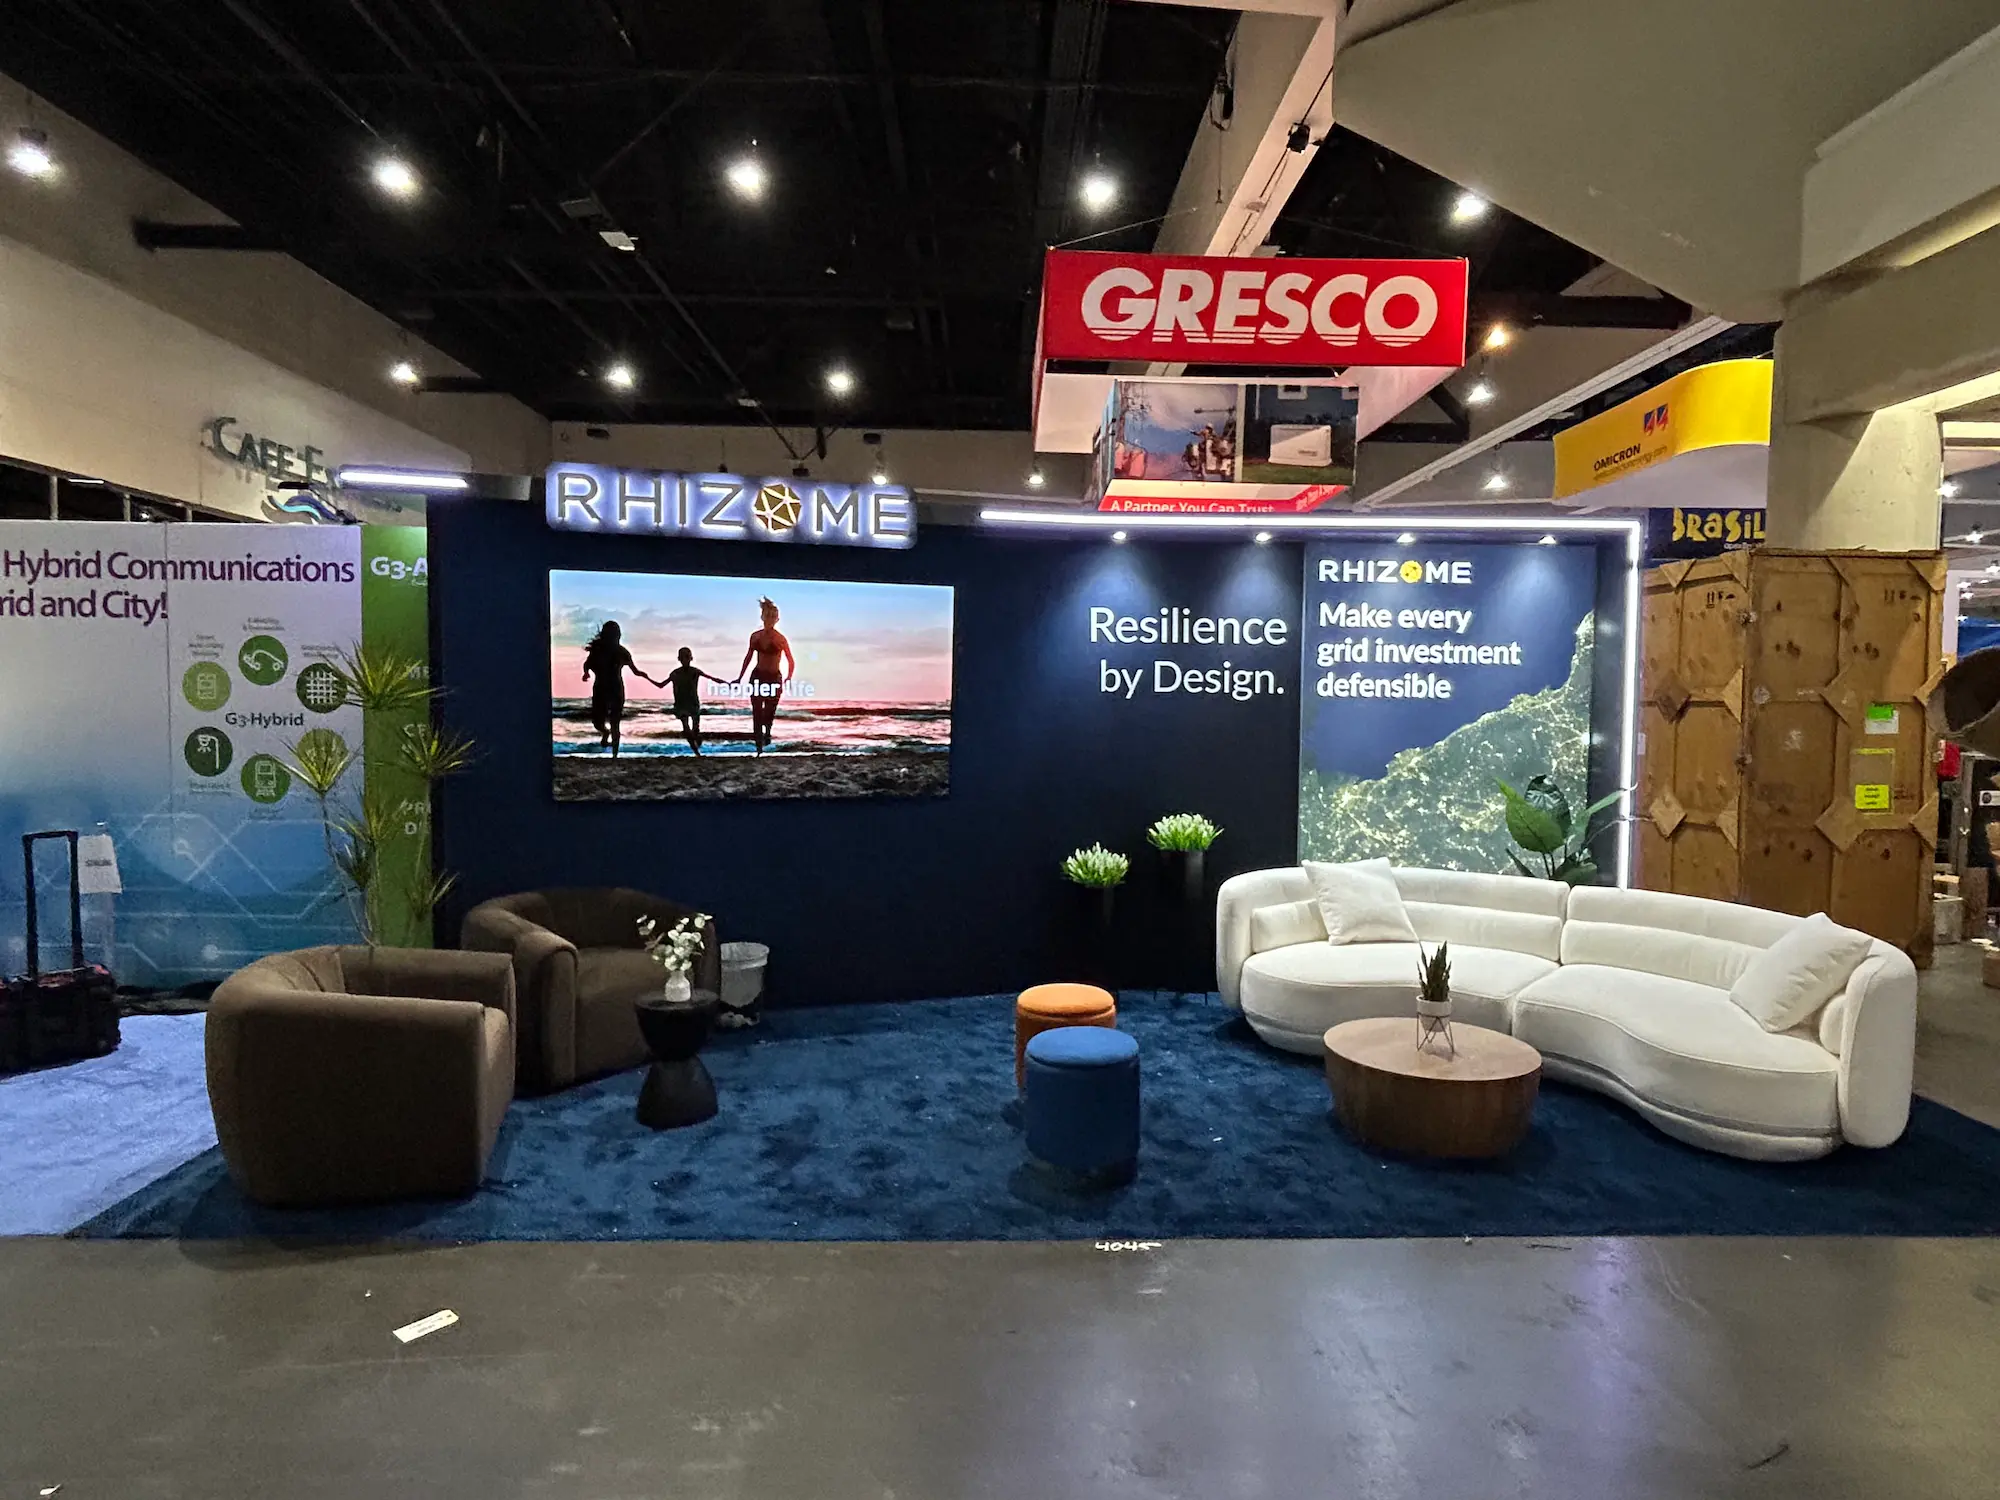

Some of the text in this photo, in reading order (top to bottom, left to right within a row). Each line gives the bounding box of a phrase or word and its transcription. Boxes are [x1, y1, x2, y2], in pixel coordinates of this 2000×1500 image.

[1081, 267, 1438, 348] GRESCO
[1594, 443, 1641, 472] OMICRON
[1124, 500, 1175, 512] Partner
[1178, 502, 1205, 512] You
[3, 549, 355, 585] Hybrid Communications
[40, 589, 97, 618] and
[102, 590, 169, 627] City!
[1319, 602, 1473, 634] Make every
[1089, 607, 1288, 646] Resilience
[1316, 637, 1522, 667] grid investment
[707, 679, 815, 699] happier life
[1100, 660, 1285, 701] by Design.
[1316, 672, 1451, 700] defensible
[225, 712, 305, 729] G3-Hybrid
